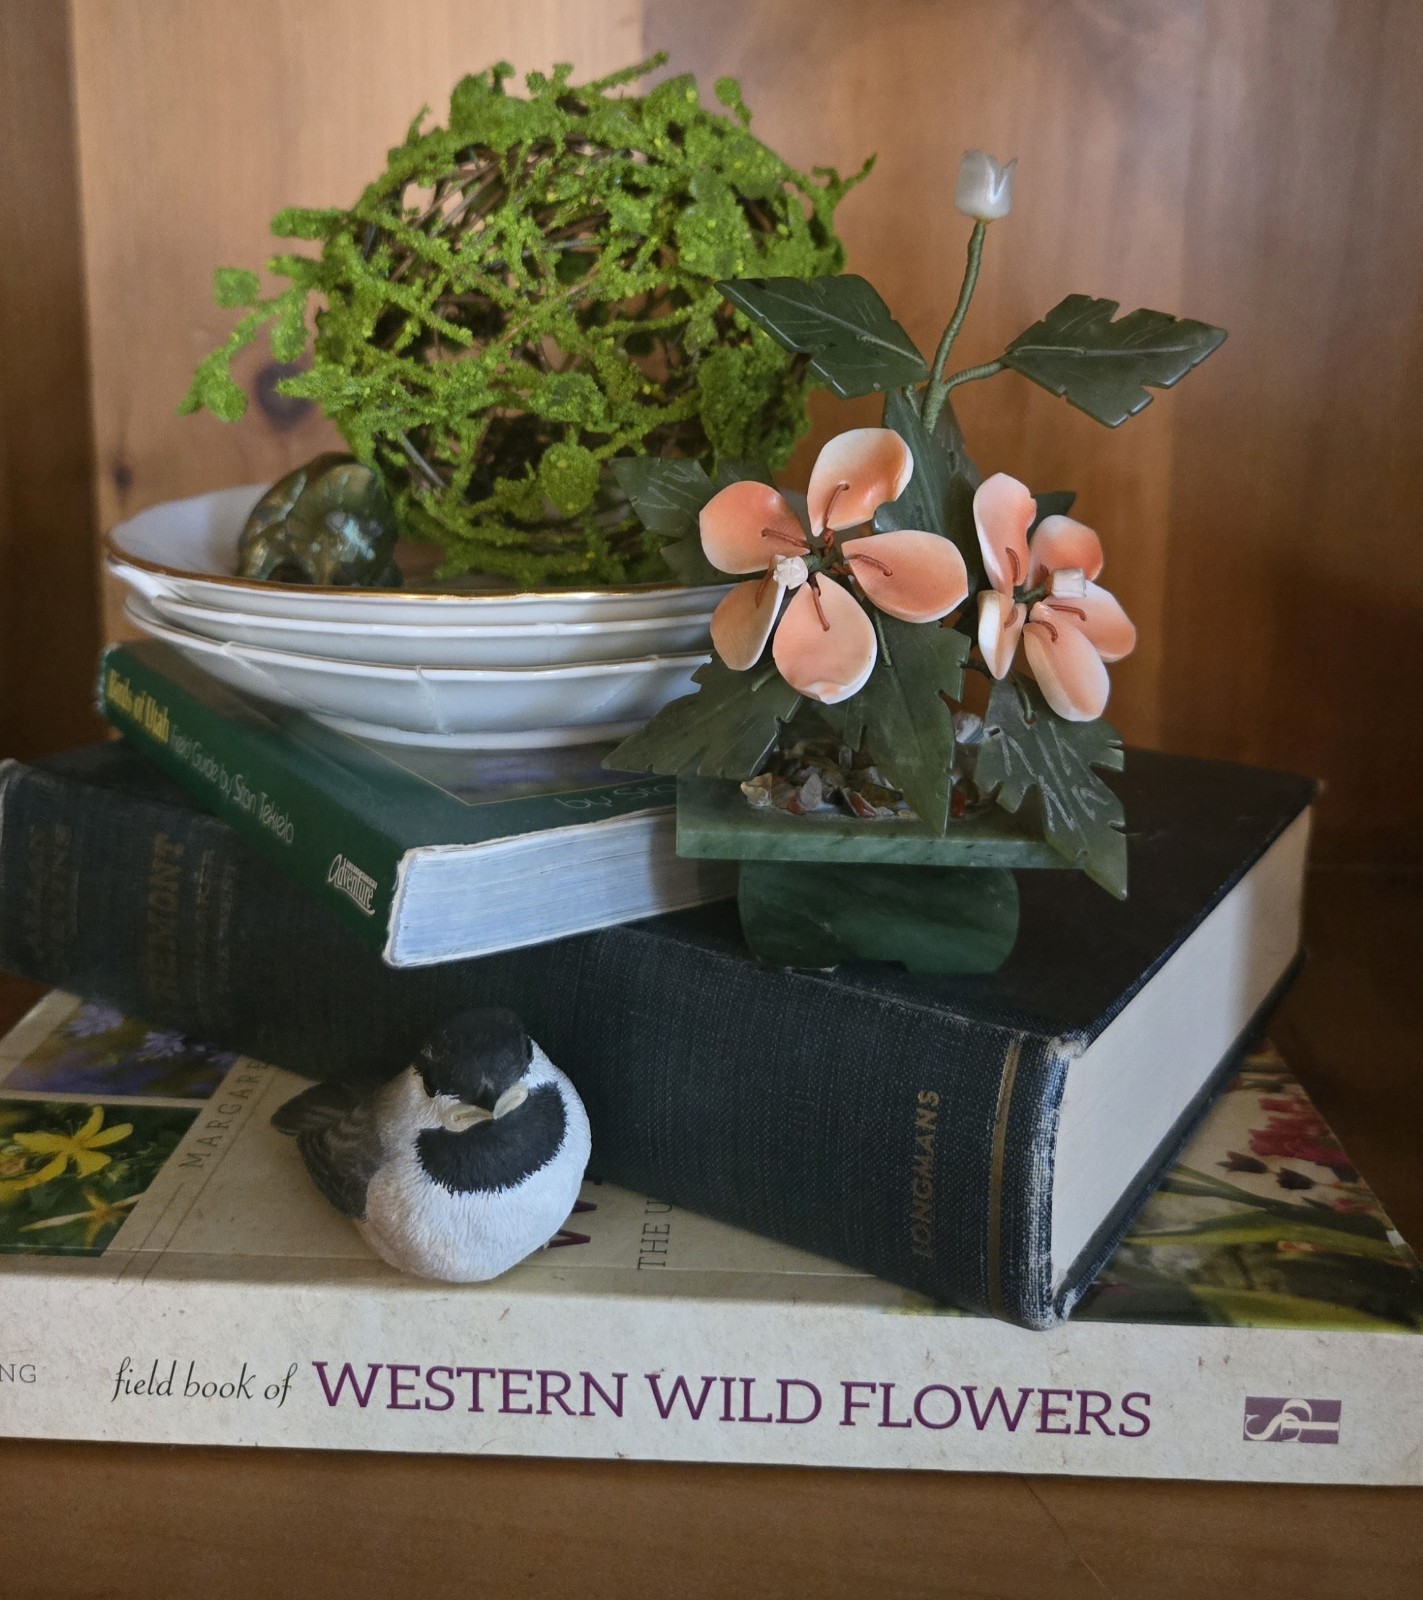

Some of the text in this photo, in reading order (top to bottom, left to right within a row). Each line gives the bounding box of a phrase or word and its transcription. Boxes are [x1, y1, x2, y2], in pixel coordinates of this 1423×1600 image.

[219, 763, 235, 799] by
[233, 774, 257, 814] Stan
[258, 792, 295, 844] Tekiela
[554, 796, 613, 808] by
[911, 1089, 940, 1258] LONGMANS
[637, 1223, 671, 1270] THE
[0, 1364, 37, 1384] NG
[111, 1356, 1152, 1437] field book of WESTERN WILD FLOWERS
